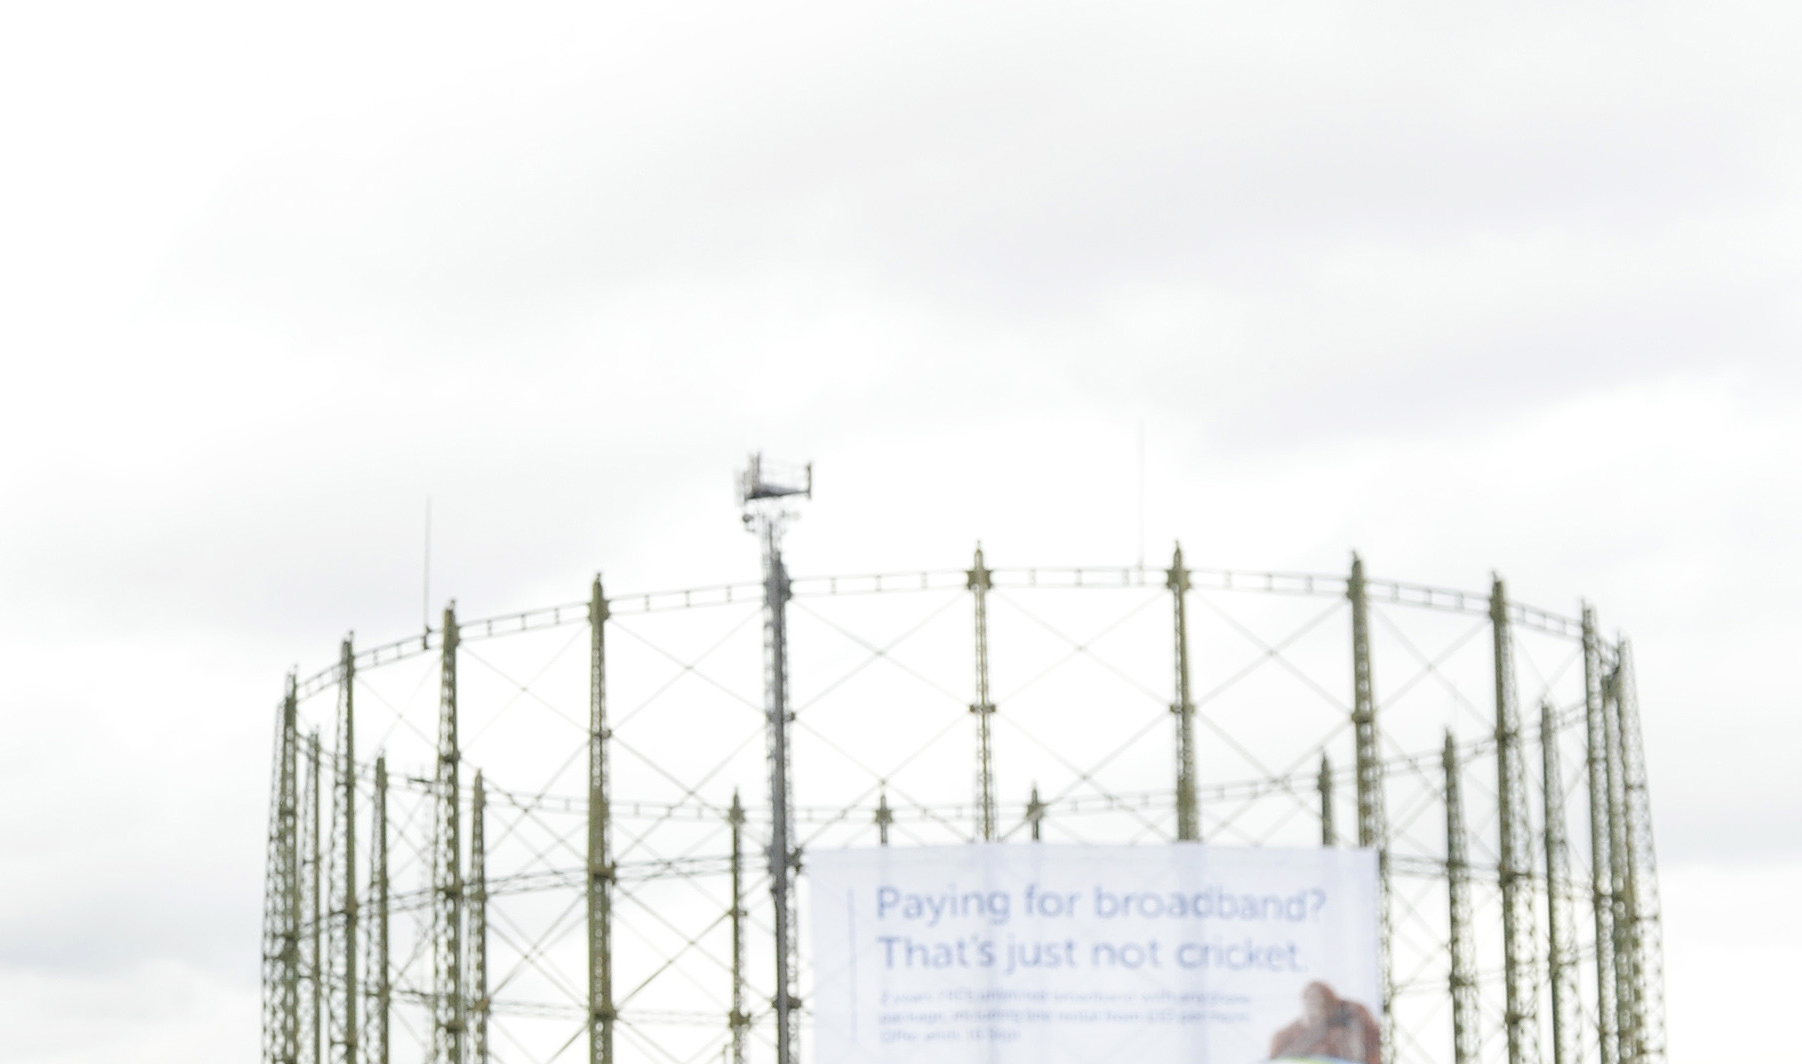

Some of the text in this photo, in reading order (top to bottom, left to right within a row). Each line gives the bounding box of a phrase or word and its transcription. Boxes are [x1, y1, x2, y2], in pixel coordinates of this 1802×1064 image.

[877, 884, 1327, 926] Paying for broadband?
[876, 935, 996, 968] That's
[1006, 934, 1078, 975] just
[1091, 937, 1162, 968] not
